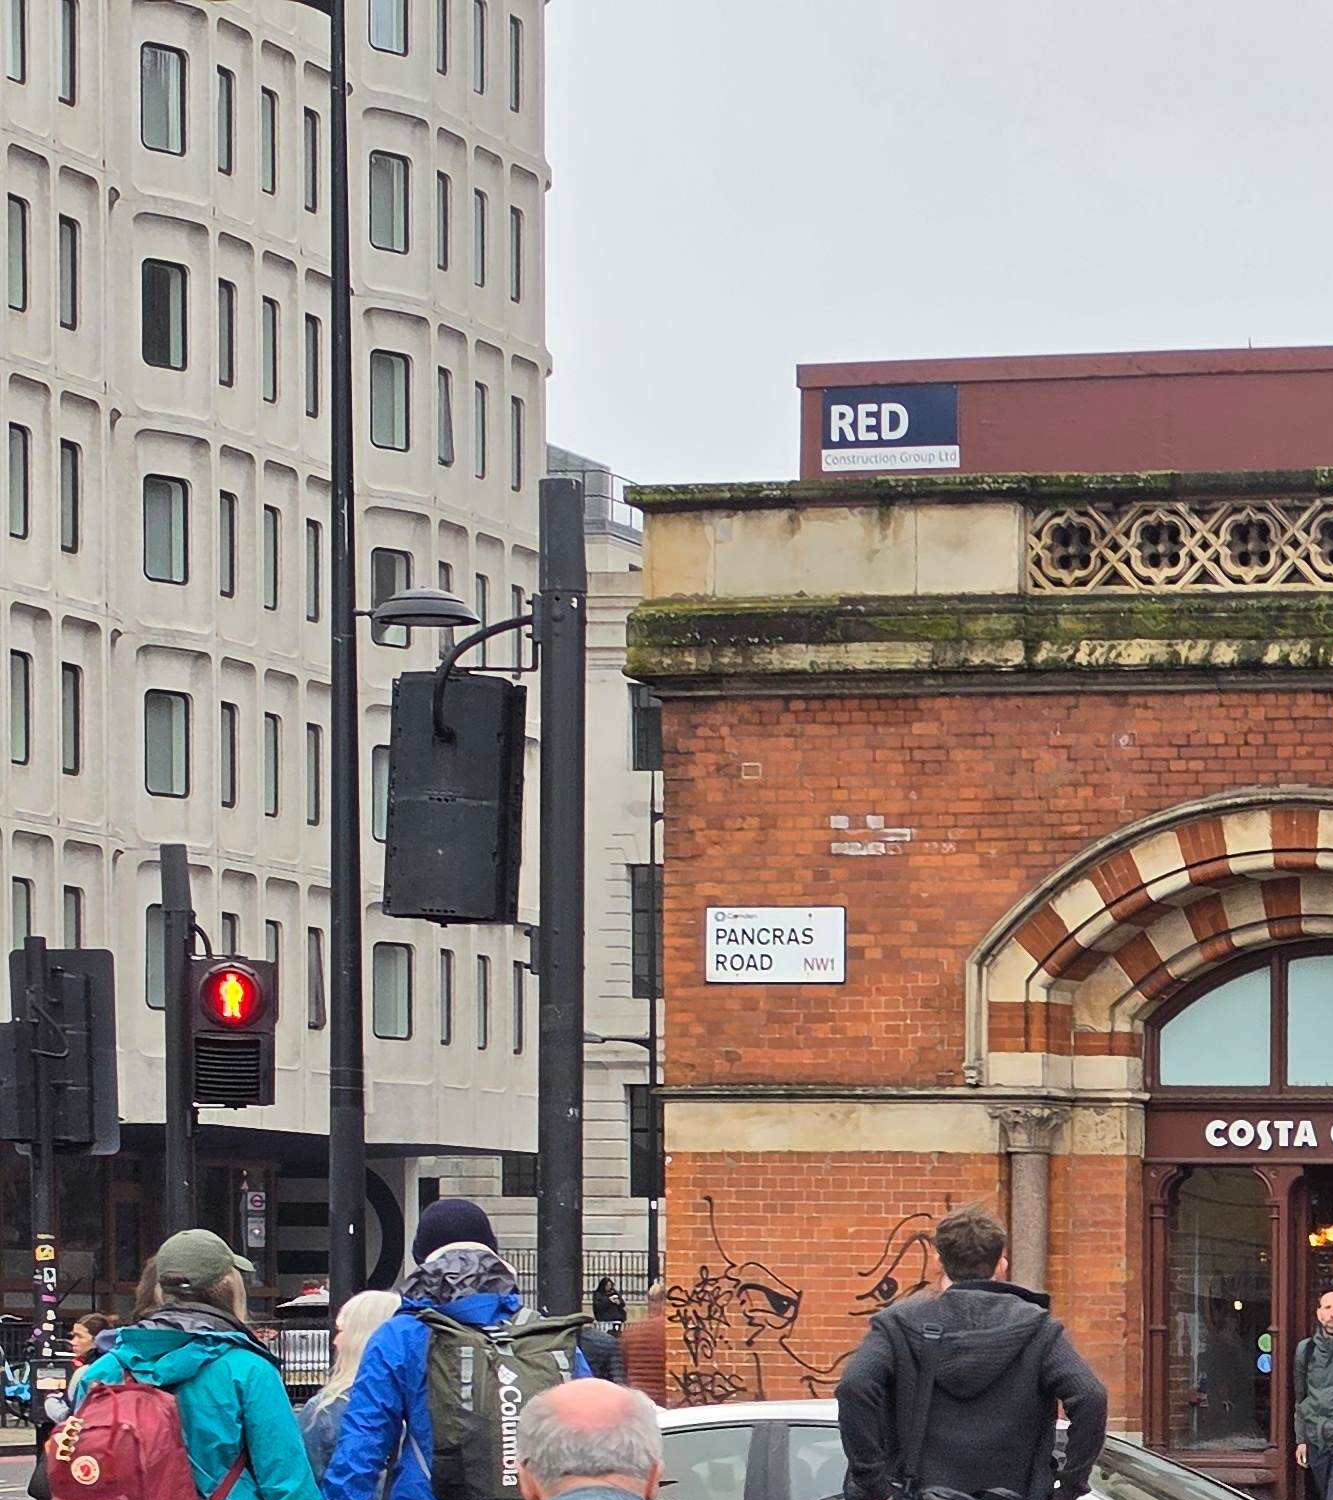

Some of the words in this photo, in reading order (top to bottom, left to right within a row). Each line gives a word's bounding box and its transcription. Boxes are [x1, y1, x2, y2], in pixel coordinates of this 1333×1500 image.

[830, 402, 909, 442] RED
[825, 454, 897, 466] Construction
[900, 451, 936, 464] Group
[939, 450, 957, 462] Ltd
[715, 927, 814, 945] PANCRAS
[715, 953, 773, 971] ROAD
[803, 957, 834, 971] NW1
[1205, 1119, 1318, 1150] COSTA
[499, 1385, 522, 1487] Columbia
